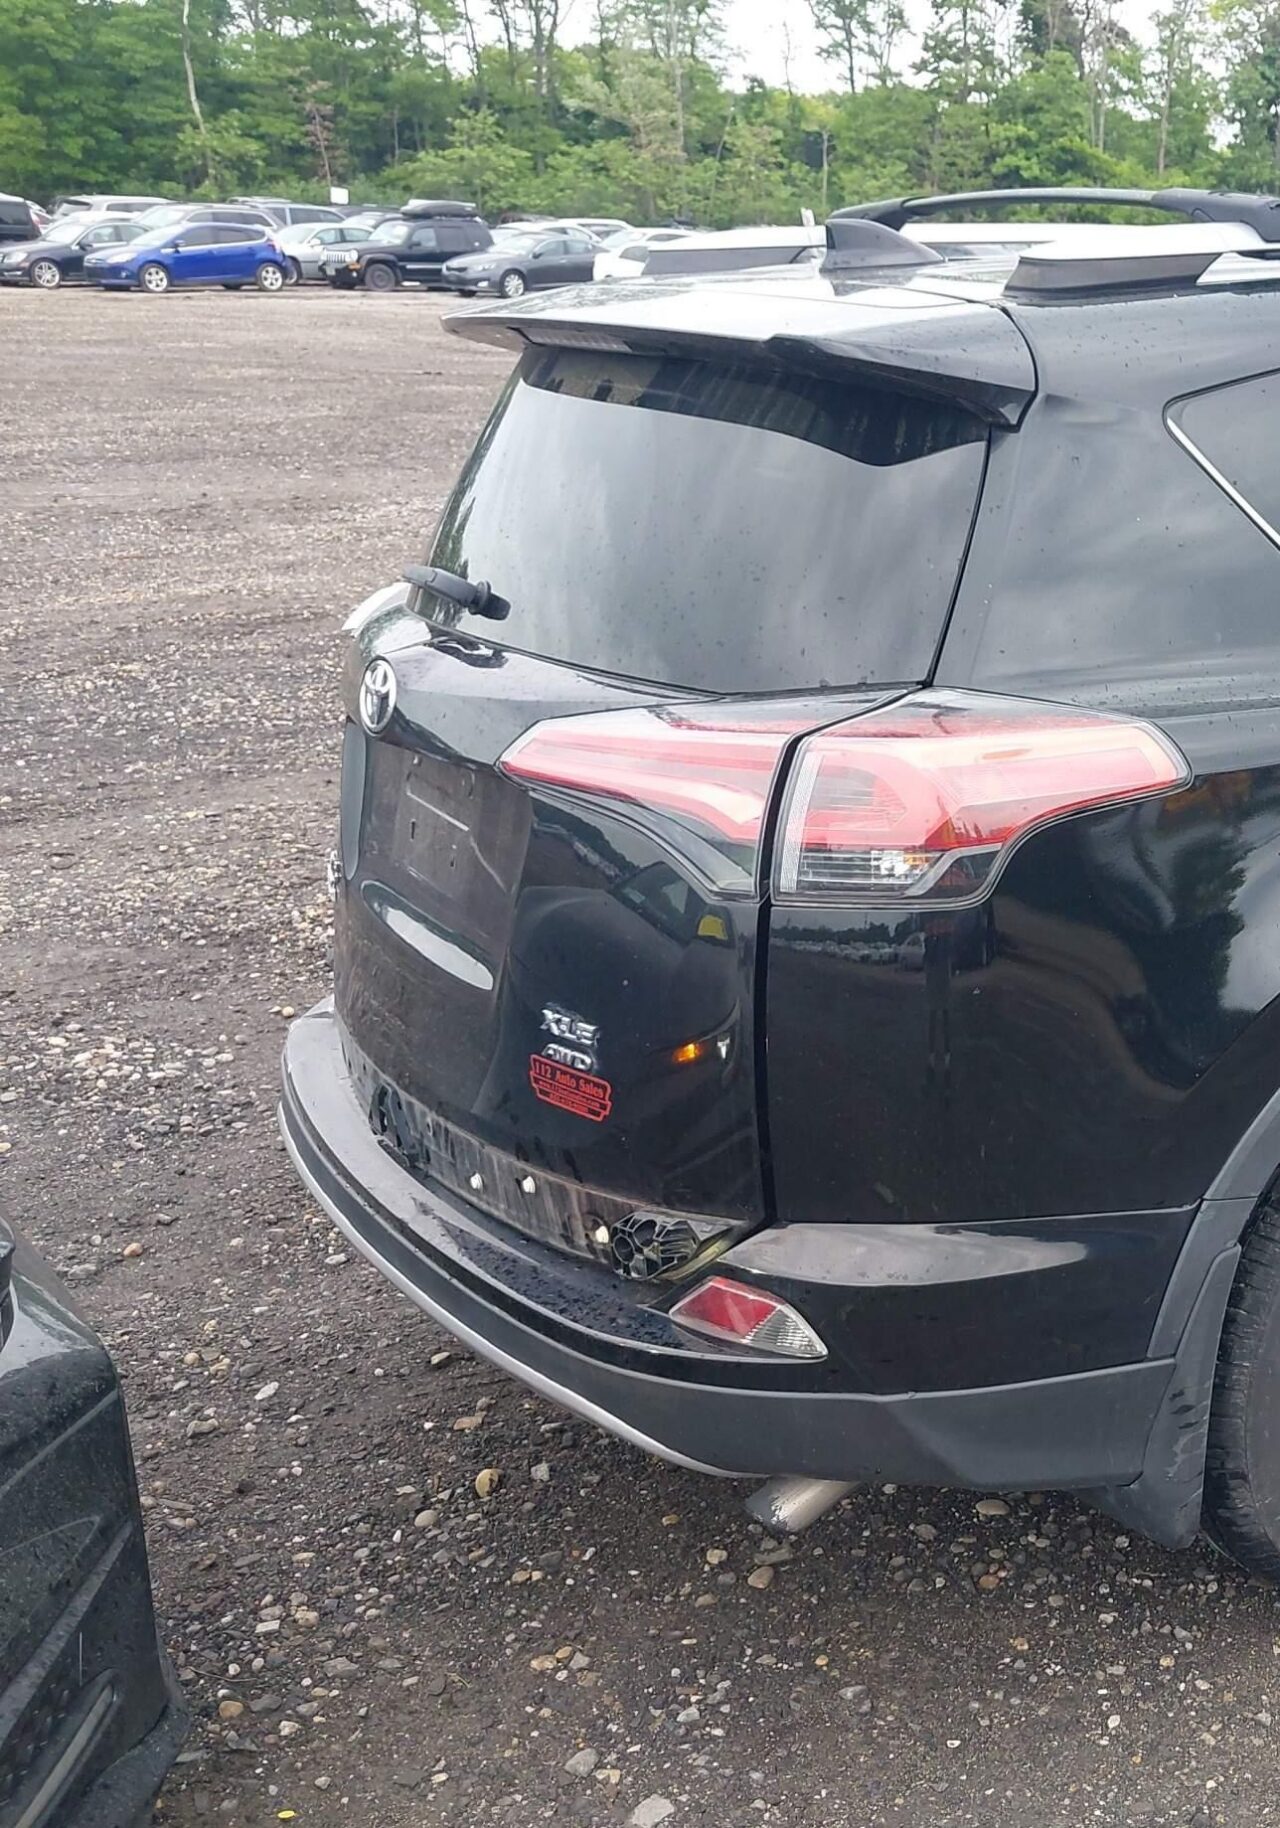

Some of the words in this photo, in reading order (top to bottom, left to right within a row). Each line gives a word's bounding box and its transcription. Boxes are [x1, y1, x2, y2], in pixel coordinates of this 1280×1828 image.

[540, 1008, 598, 1044] XLE
[541, 1043, 592, 1070] AWD
[535, 1061, 552, 1078] 112
[555, 1070, 577, 1088] Auto
[579, 1079, 604, 1098] Sales
